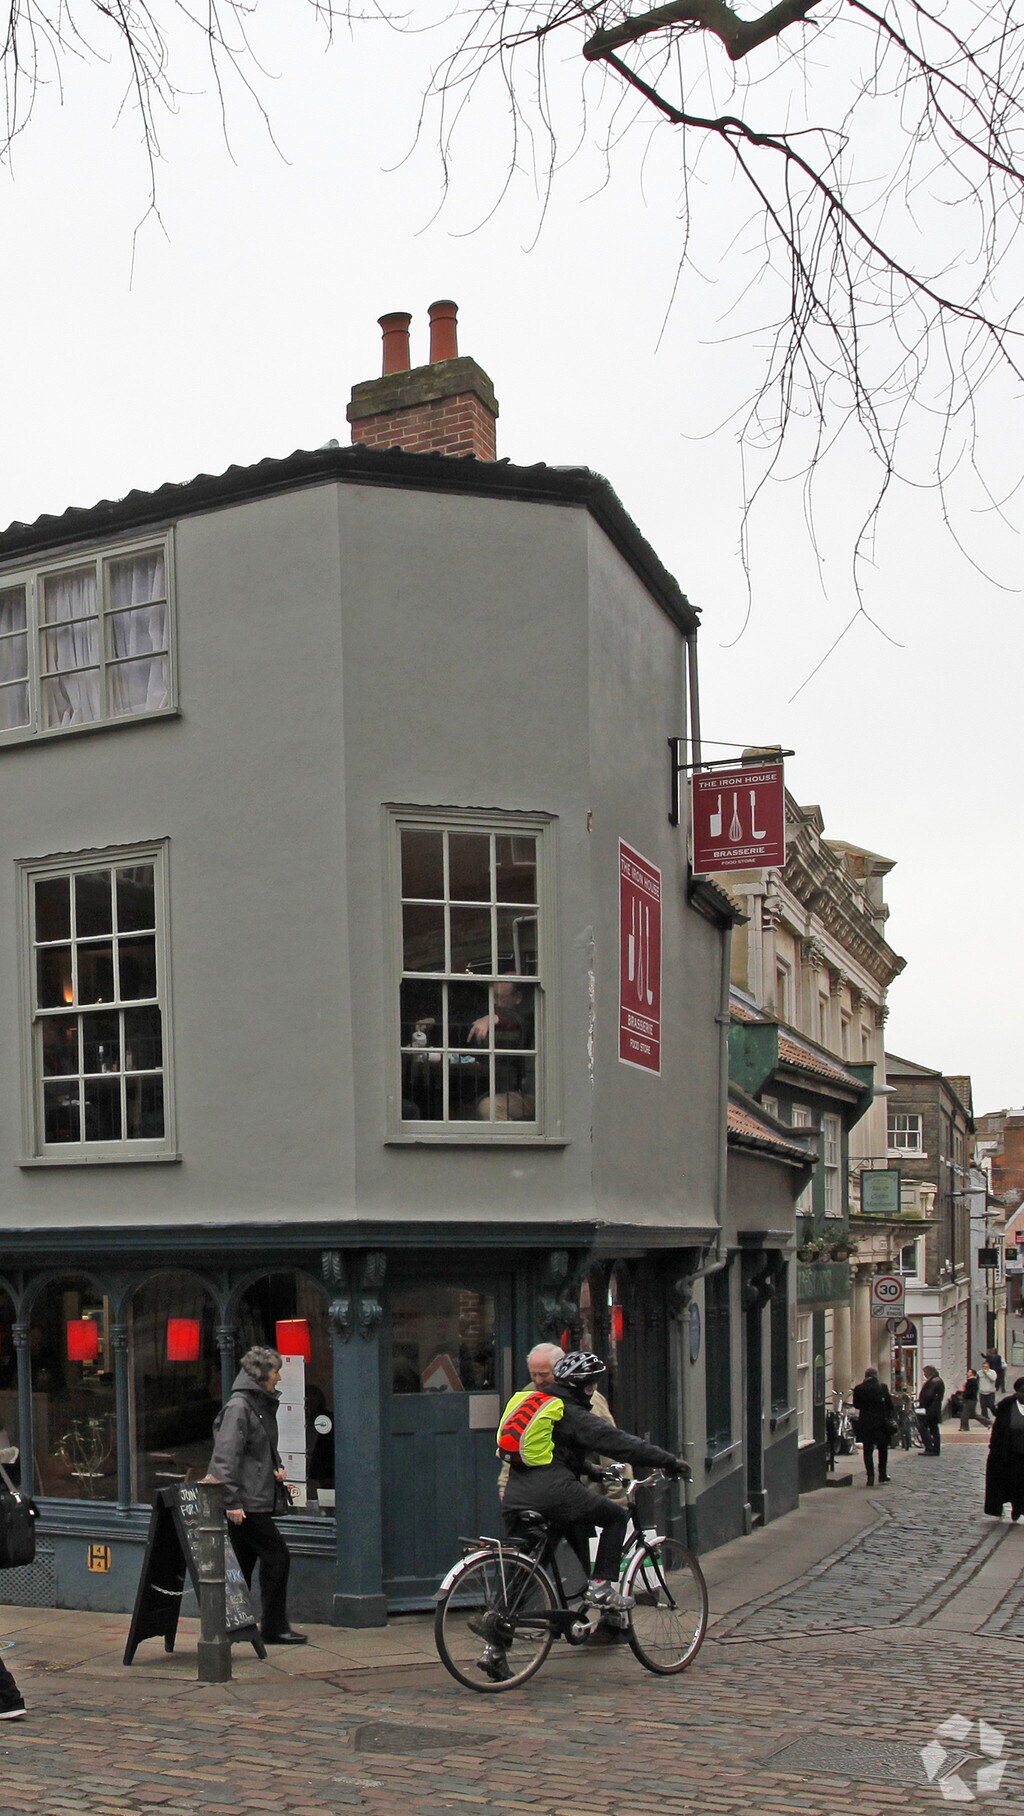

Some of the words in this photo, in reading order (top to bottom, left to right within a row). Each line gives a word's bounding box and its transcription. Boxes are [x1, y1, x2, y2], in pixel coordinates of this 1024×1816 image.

[699, 780, 717, 789] THE
[719, 777, 742, 787] IRON
[744, 773, 777, 784] HOUSE
[713, 847, 765, 858] BRASSERIE
[621, 859, 631, 876] THE
[631, 866, 644, 886] IRON
[643, 877, 660, 898] HOUSE
[627, 1014, 654, 1036] BRASSERIE
[629, 1038, 640, 1051] FOOD
[639, 1042, 651, 1055] STORE
[879, 1285, 898, 1296] 30
